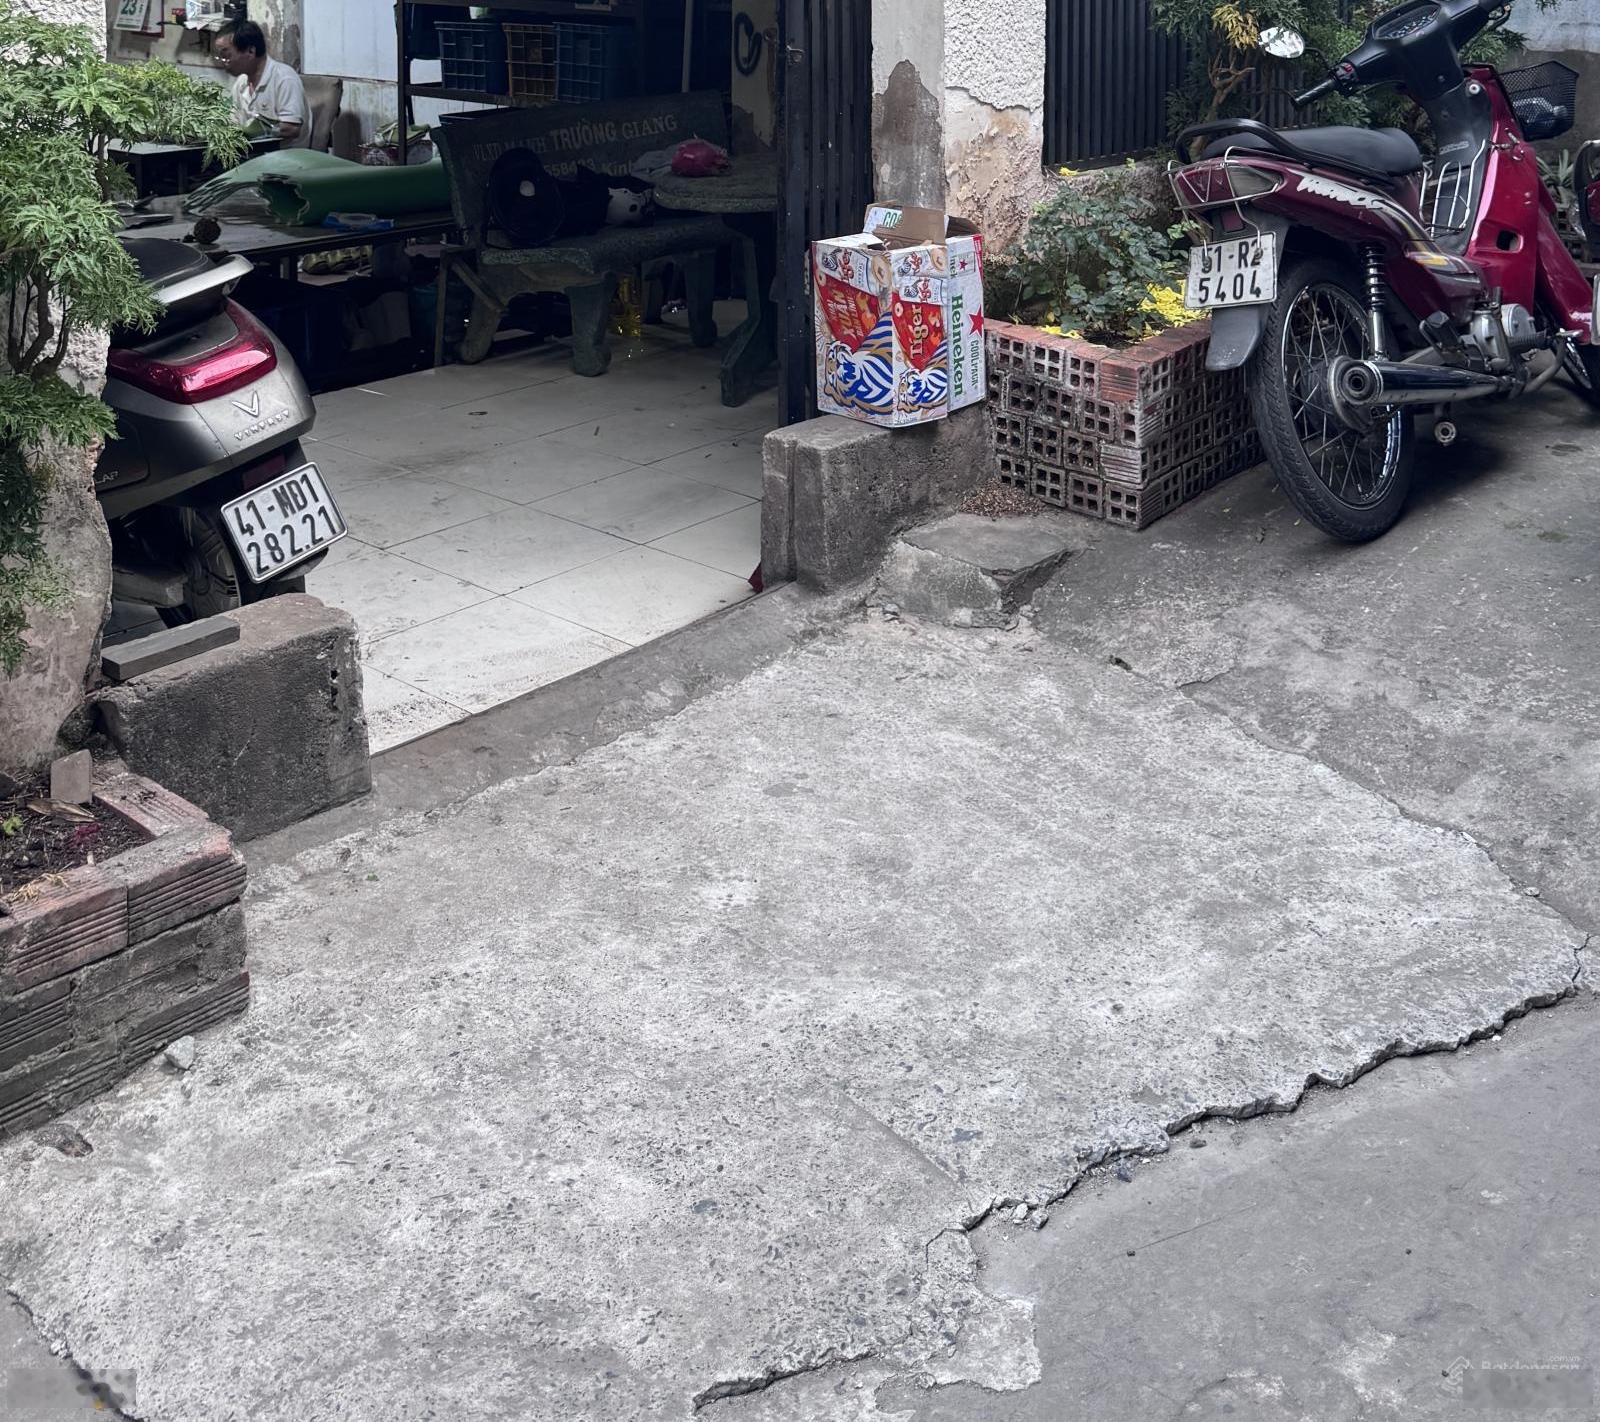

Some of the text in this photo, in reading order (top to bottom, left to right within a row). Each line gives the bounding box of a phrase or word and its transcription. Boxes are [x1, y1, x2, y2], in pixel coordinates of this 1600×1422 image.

[549, 118, 617, 152] TRƯỜNG
[622, 114, 678, 139] GIANG
[1199, 270, 1262, 304] 5404
[910, 304, 929, 358] Tiger
[950, 294, 964, 397] Heineken
[246, 506, 337, 576] 282.21
